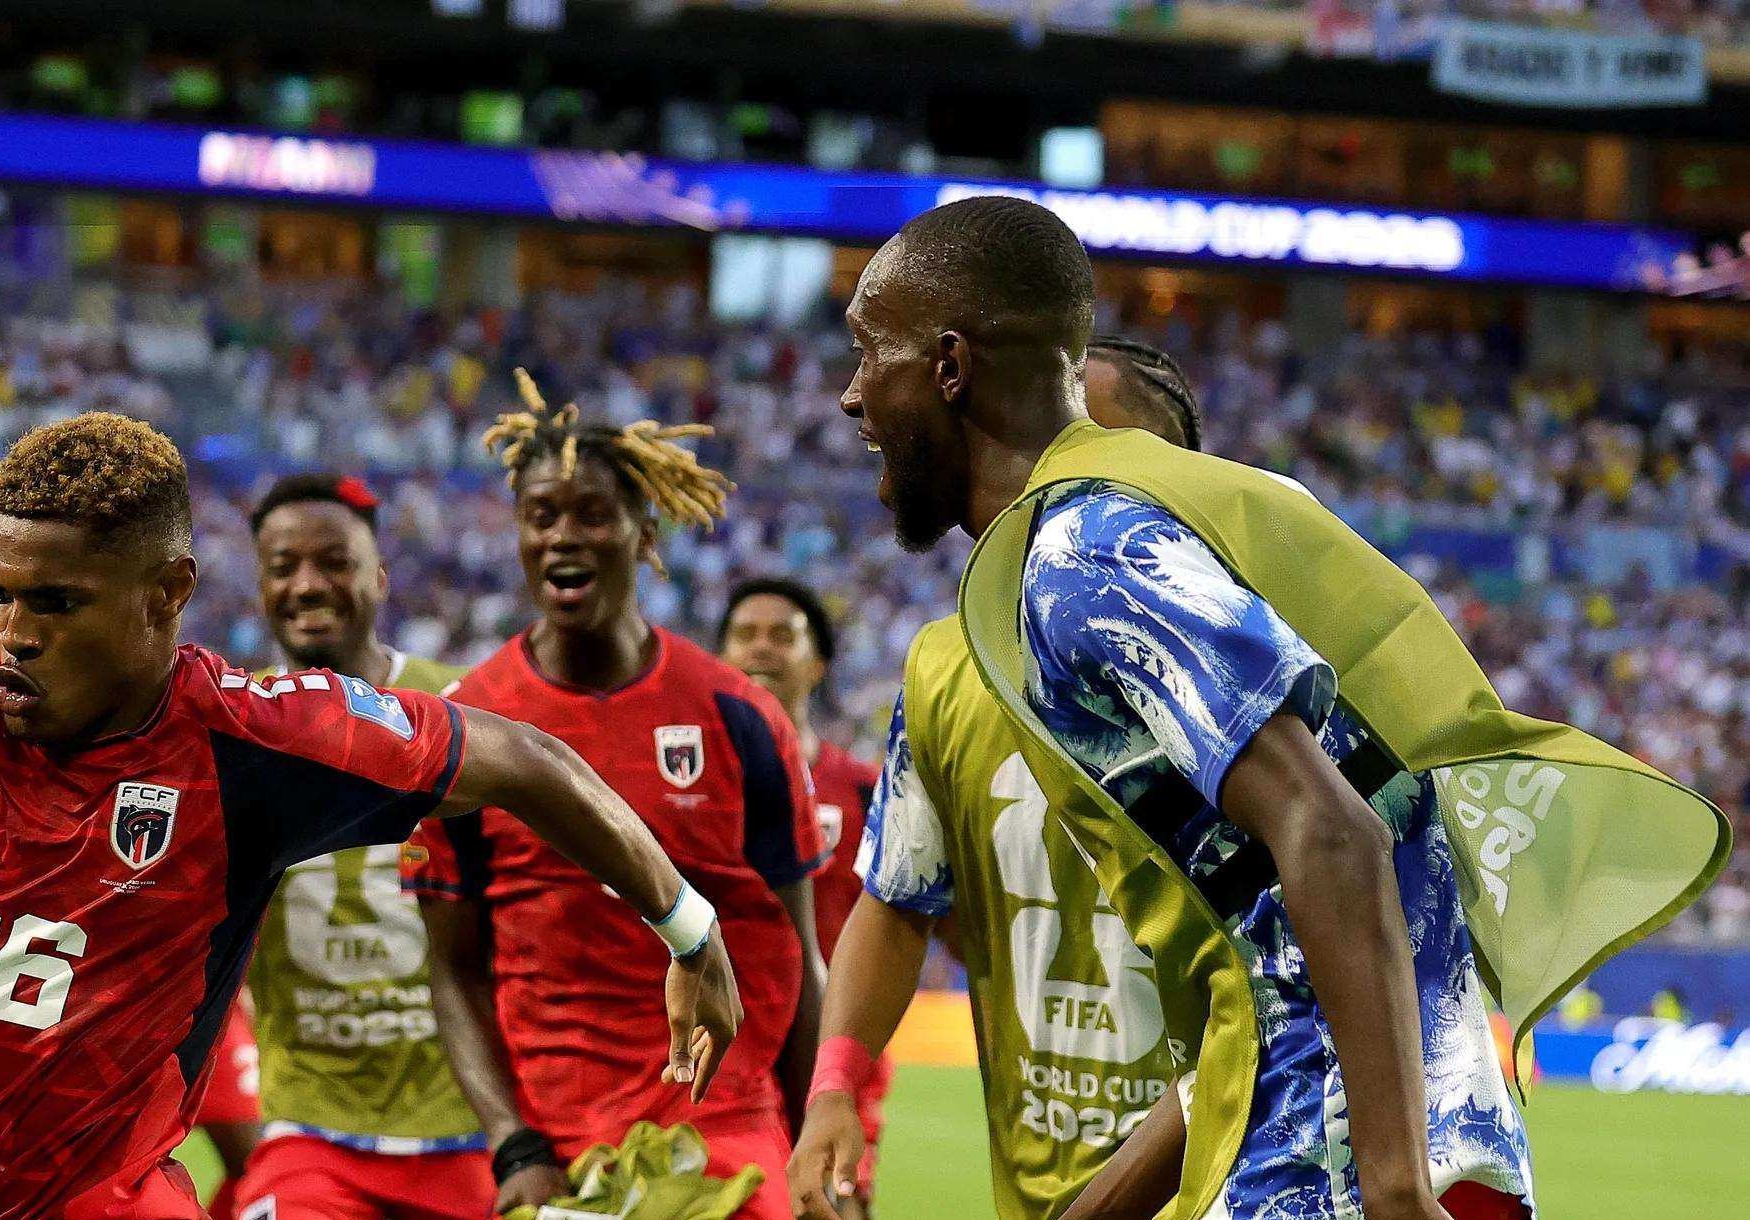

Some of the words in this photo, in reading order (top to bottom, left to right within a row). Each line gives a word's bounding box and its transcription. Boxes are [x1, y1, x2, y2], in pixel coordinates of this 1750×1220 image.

[122, 786, 174, 801] FCF
[1044, 996, 1118, 1034] FIFA
[1104, 1075, 1168, 1104] CUP
